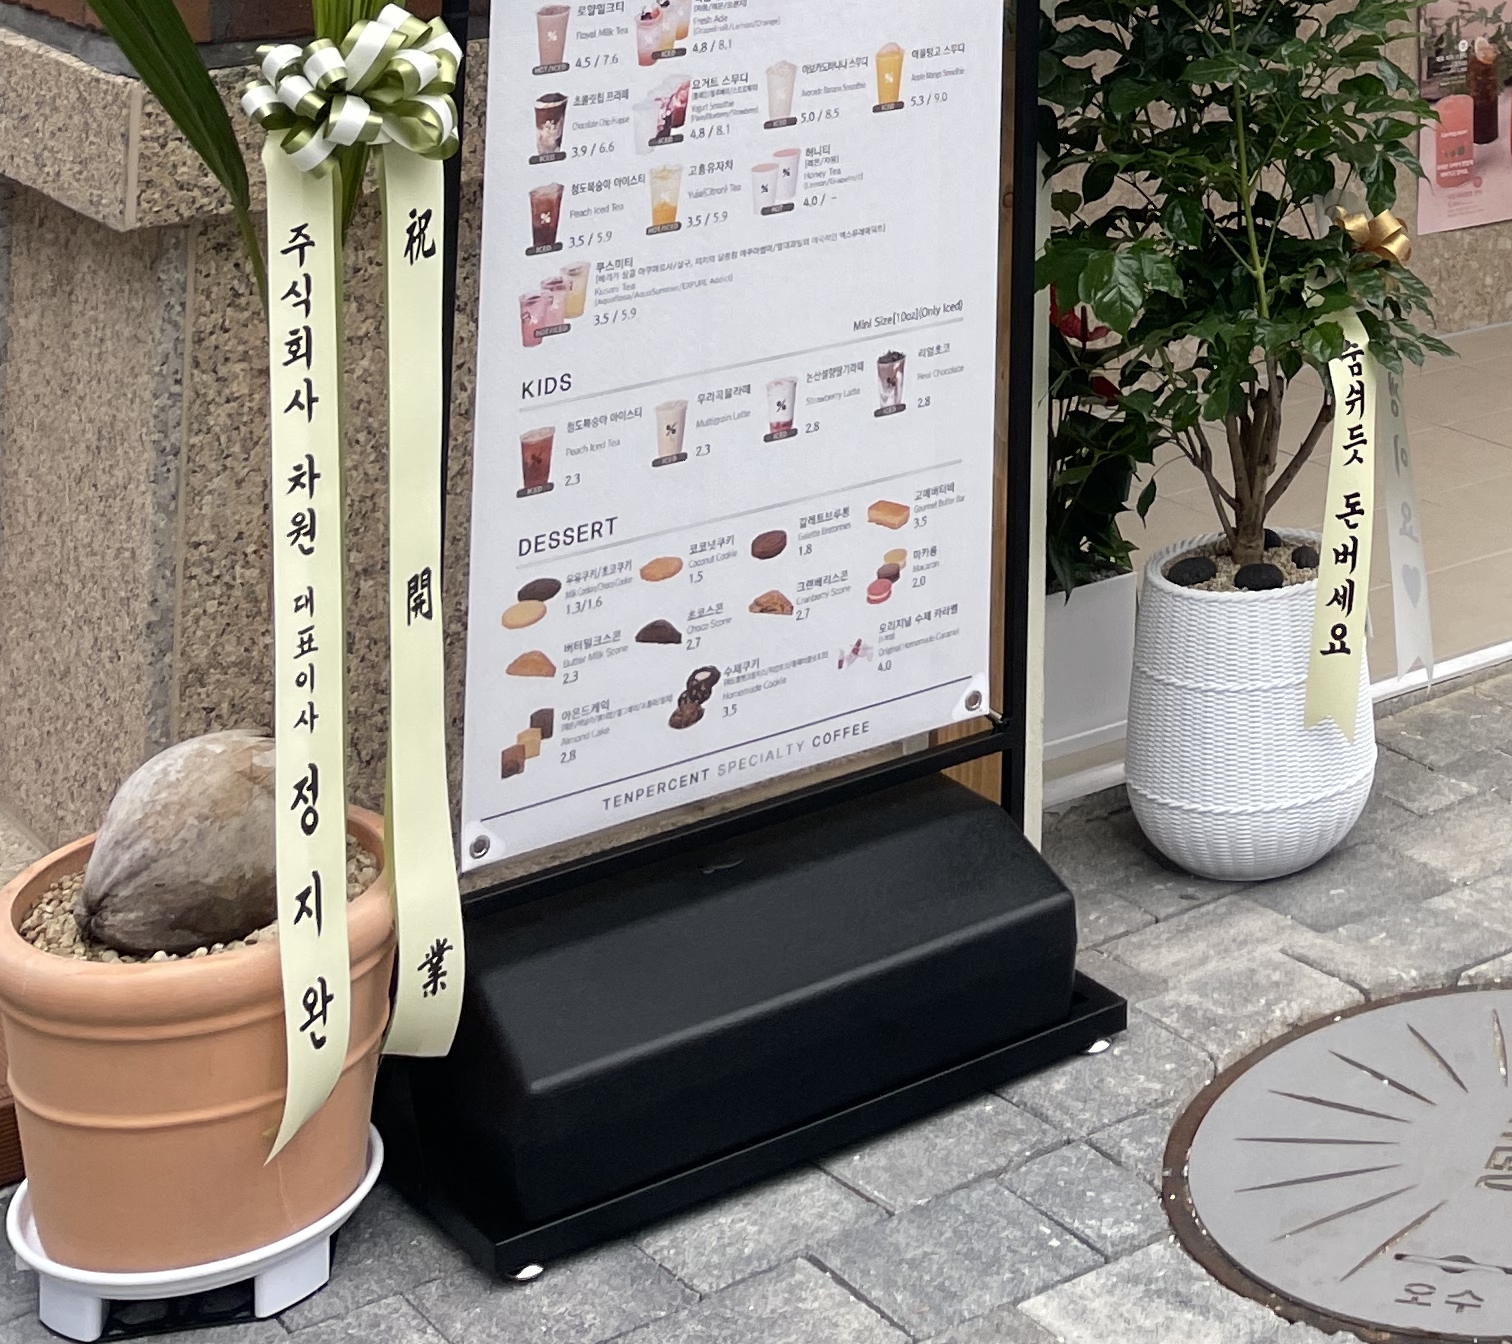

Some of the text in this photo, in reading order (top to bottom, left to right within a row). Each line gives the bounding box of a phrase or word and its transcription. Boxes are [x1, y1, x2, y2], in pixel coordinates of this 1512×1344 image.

[575, 54, 618, 69] 4.5 7.6
[691, 73, 749, 90] 요거트 스무디
[801, 113, 814, 123] 5.0
[572, 142, 615, 158] 3.9 6.6
[613, 174, 646, 187] 아이스티
[803, 196, 818, 207] 4.0
[569, 231, 612, 248] 3.5 5.9
[594, 308, 637, 326] 3.5 5.9
[853, 319, 872, 331] Mini
[522, 373, 572, 399] KIDS
[918, 396, 930, 408] 2.8
[805, 422, 820, 434] 2.8
[696, 445, 711, 456] 2.3
[565, 474, 580, 486] 2.3
[1320, 341, 1368, 656] 숨쉬듯 돈버세요
[518, 517, 618, 557] DESSERT
[799, 544, 812, 556] 1.8
[689, 572, 703, 584] 1.5
[912, 576, 925, 587] 2.0
[566, 597, 603, 615] 1.3/1.6
[796, 609, 810, 620] 2.7
[280, 222, 334, 1050] 주식회사 차원 대표이사 정지완
[686, 638, 701, 650] 2.7
[878, 661, 891, 671] 4.0
[563, 671, 578, 684] 2.3
[560, 750, 576, 764] 2.8
[603, 721, 870, 810] TENPERCENT SPECIALTY COFFEE
[1395, 1282, 1484, 1313] 오수
